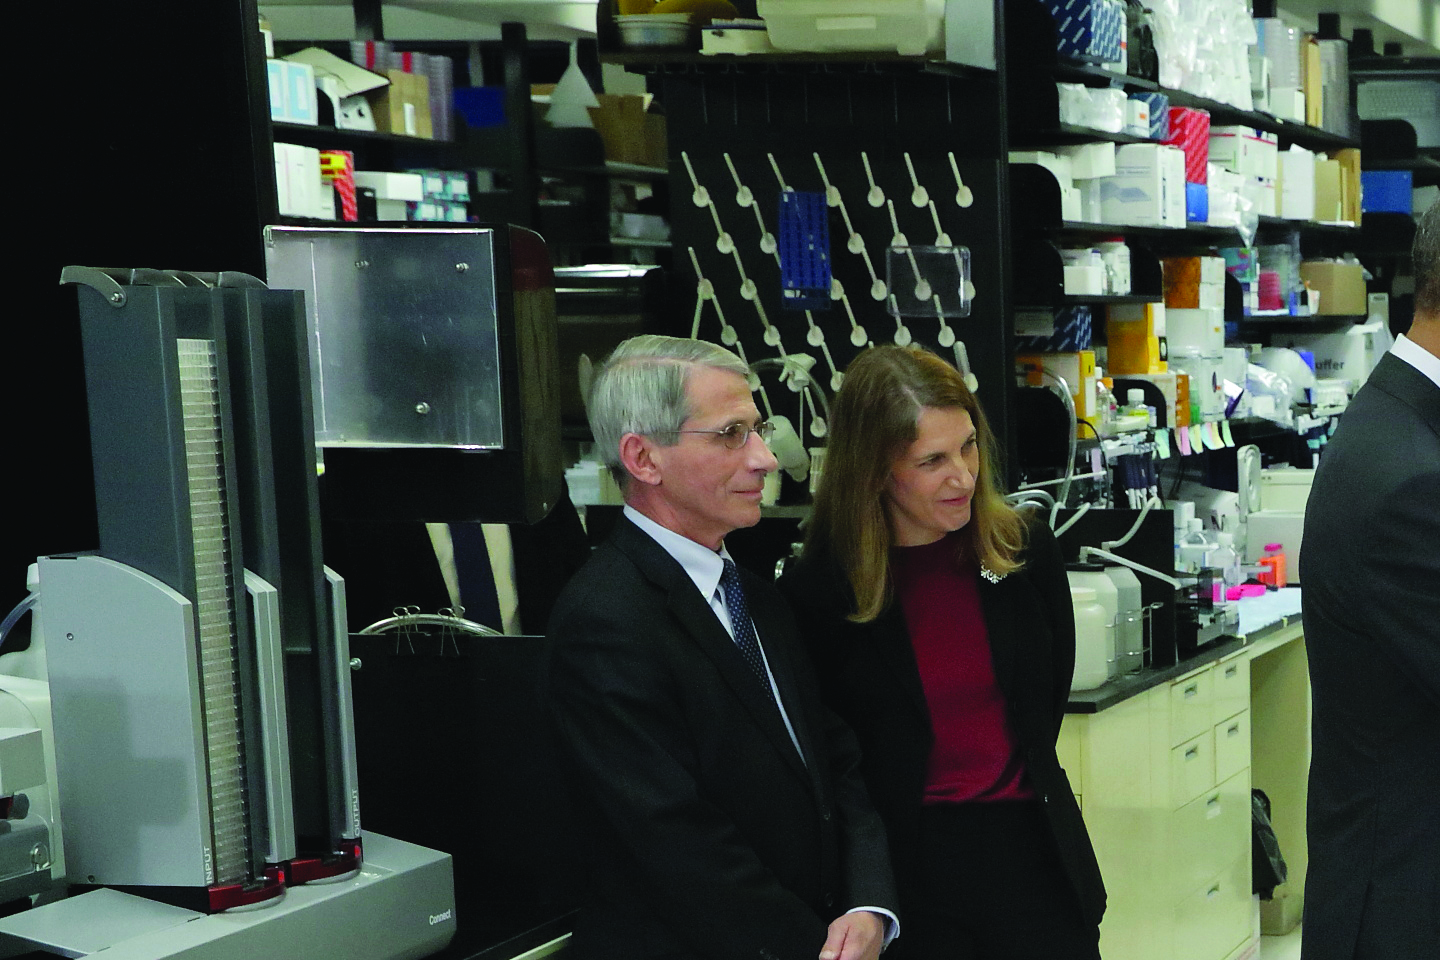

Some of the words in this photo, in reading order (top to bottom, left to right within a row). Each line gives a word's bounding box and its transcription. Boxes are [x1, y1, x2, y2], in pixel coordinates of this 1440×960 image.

[1315, 358, 1345, 370] uffer
[352, 788, 360, 837] OUTPUT
[429, 908, 452, 926] Connect
